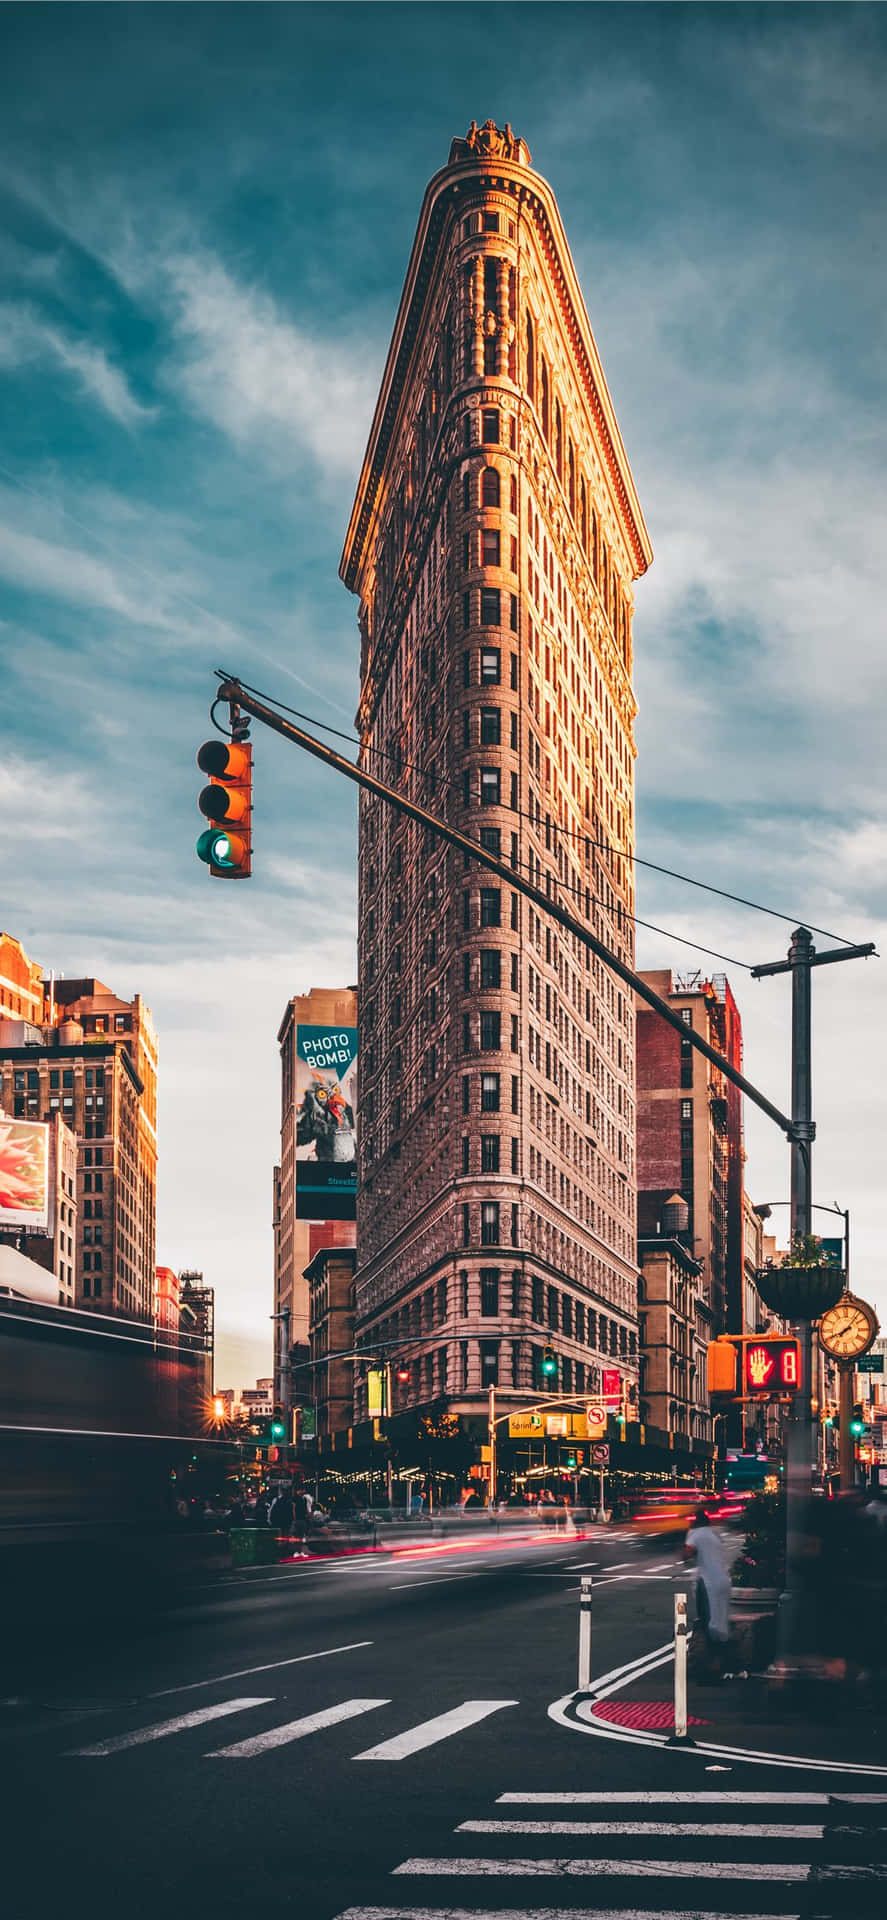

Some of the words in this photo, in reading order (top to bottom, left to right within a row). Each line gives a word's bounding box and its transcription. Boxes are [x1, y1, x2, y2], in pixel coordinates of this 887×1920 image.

[302, 1033, 349, 1054] PHOTO
[306, 1049, 352, 1069] BOMB!
[783, 1351, 797, 1383] 8
[511, 1422, 532, 1433] Sprint
